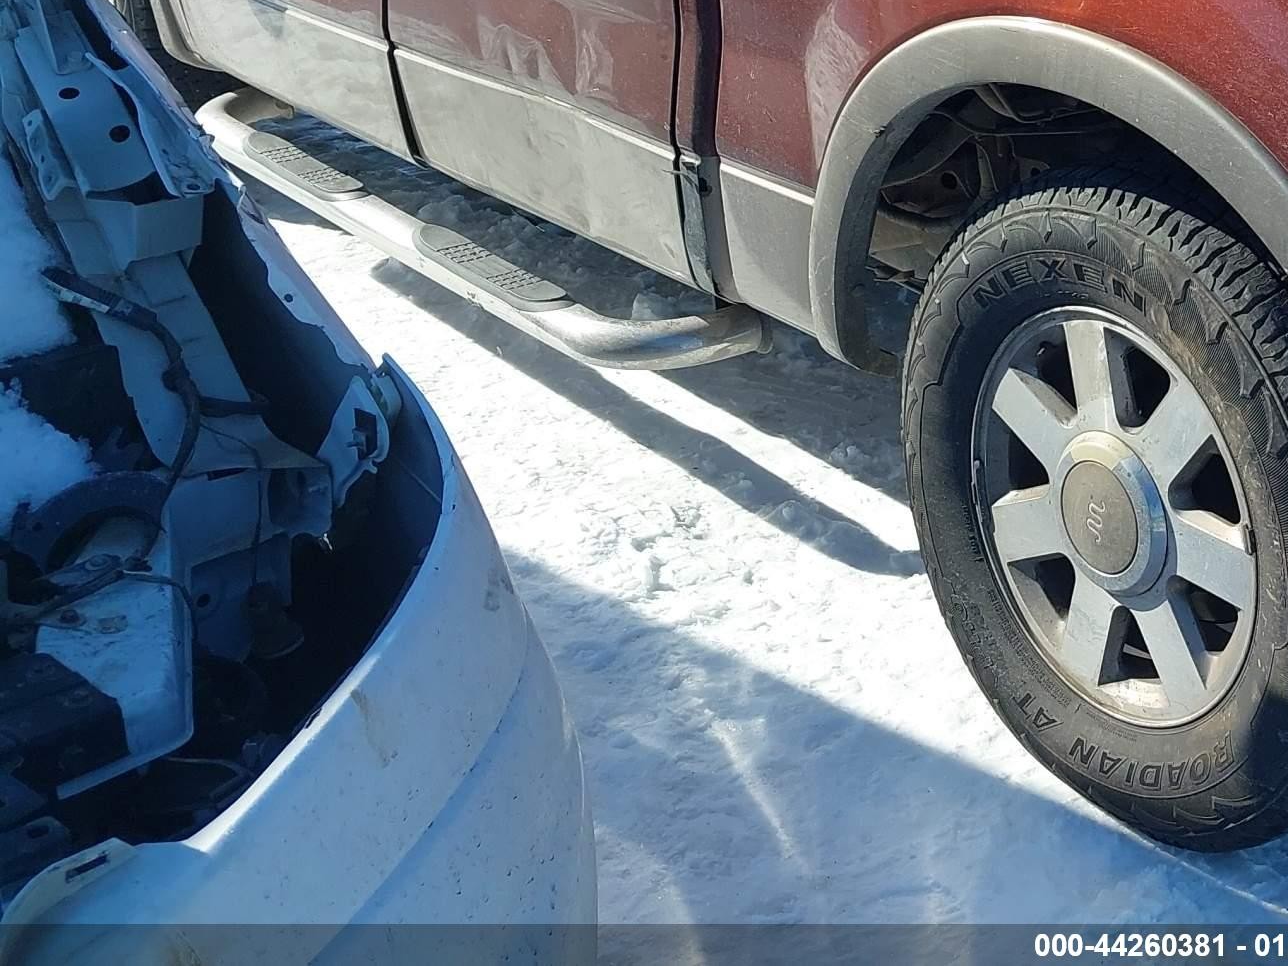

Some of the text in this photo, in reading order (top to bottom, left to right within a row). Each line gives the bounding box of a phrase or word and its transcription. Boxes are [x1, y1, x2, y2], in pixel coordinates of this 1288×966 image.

[972, 256, 1147, 316] NEXEN
[1010, 692, 1064, 733] AT
[1069, 730, 1236, 791] ROADIAN
